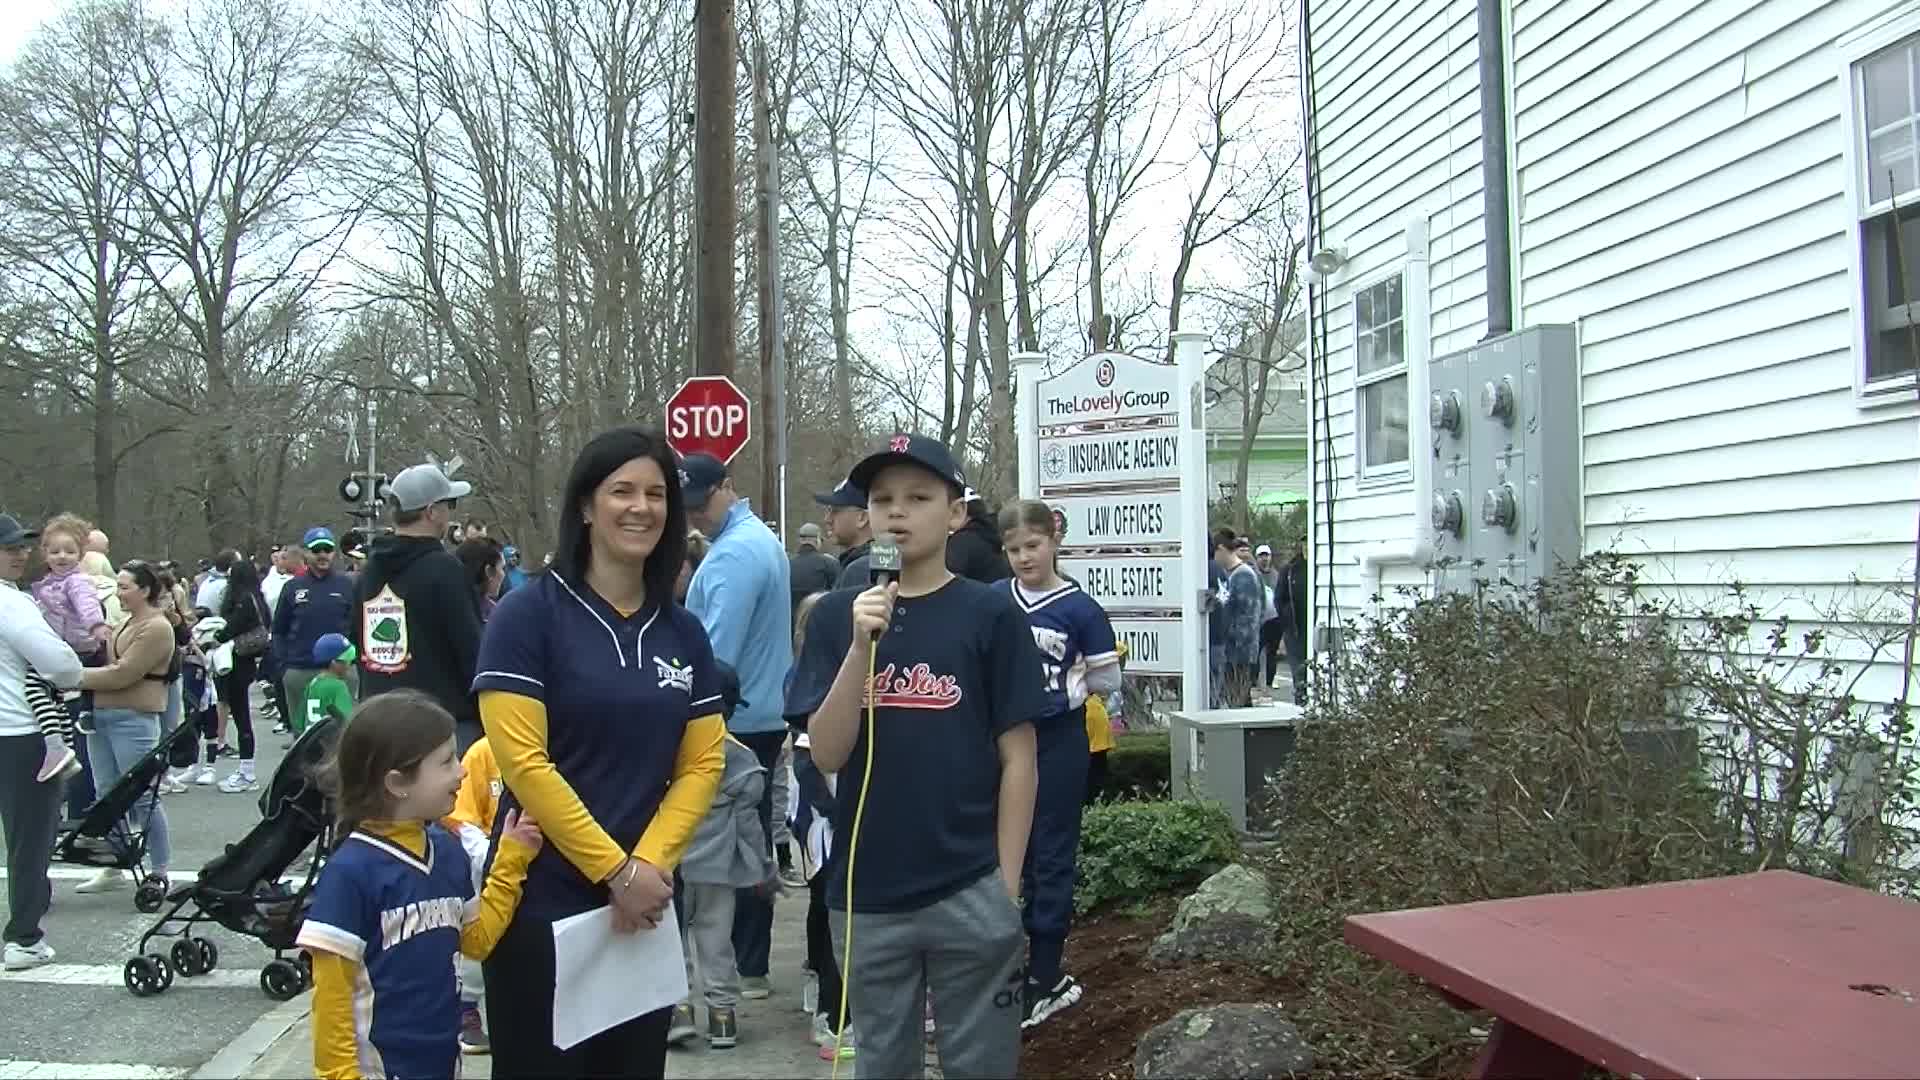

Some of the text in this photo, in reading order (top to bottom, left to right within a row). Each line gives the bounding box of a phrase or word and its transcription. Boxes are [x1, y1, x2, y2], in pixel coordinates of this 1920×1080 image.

[672, 405, 744, 438] STOP
[1069, 435, 1178, 473] INSURANCE AGENCY
[1087, 503, 1163, 536] LAW OFFICES
[1088, 567, 1163, 597] REAL ESTATE
[894, 662, 958, 697] Sox
